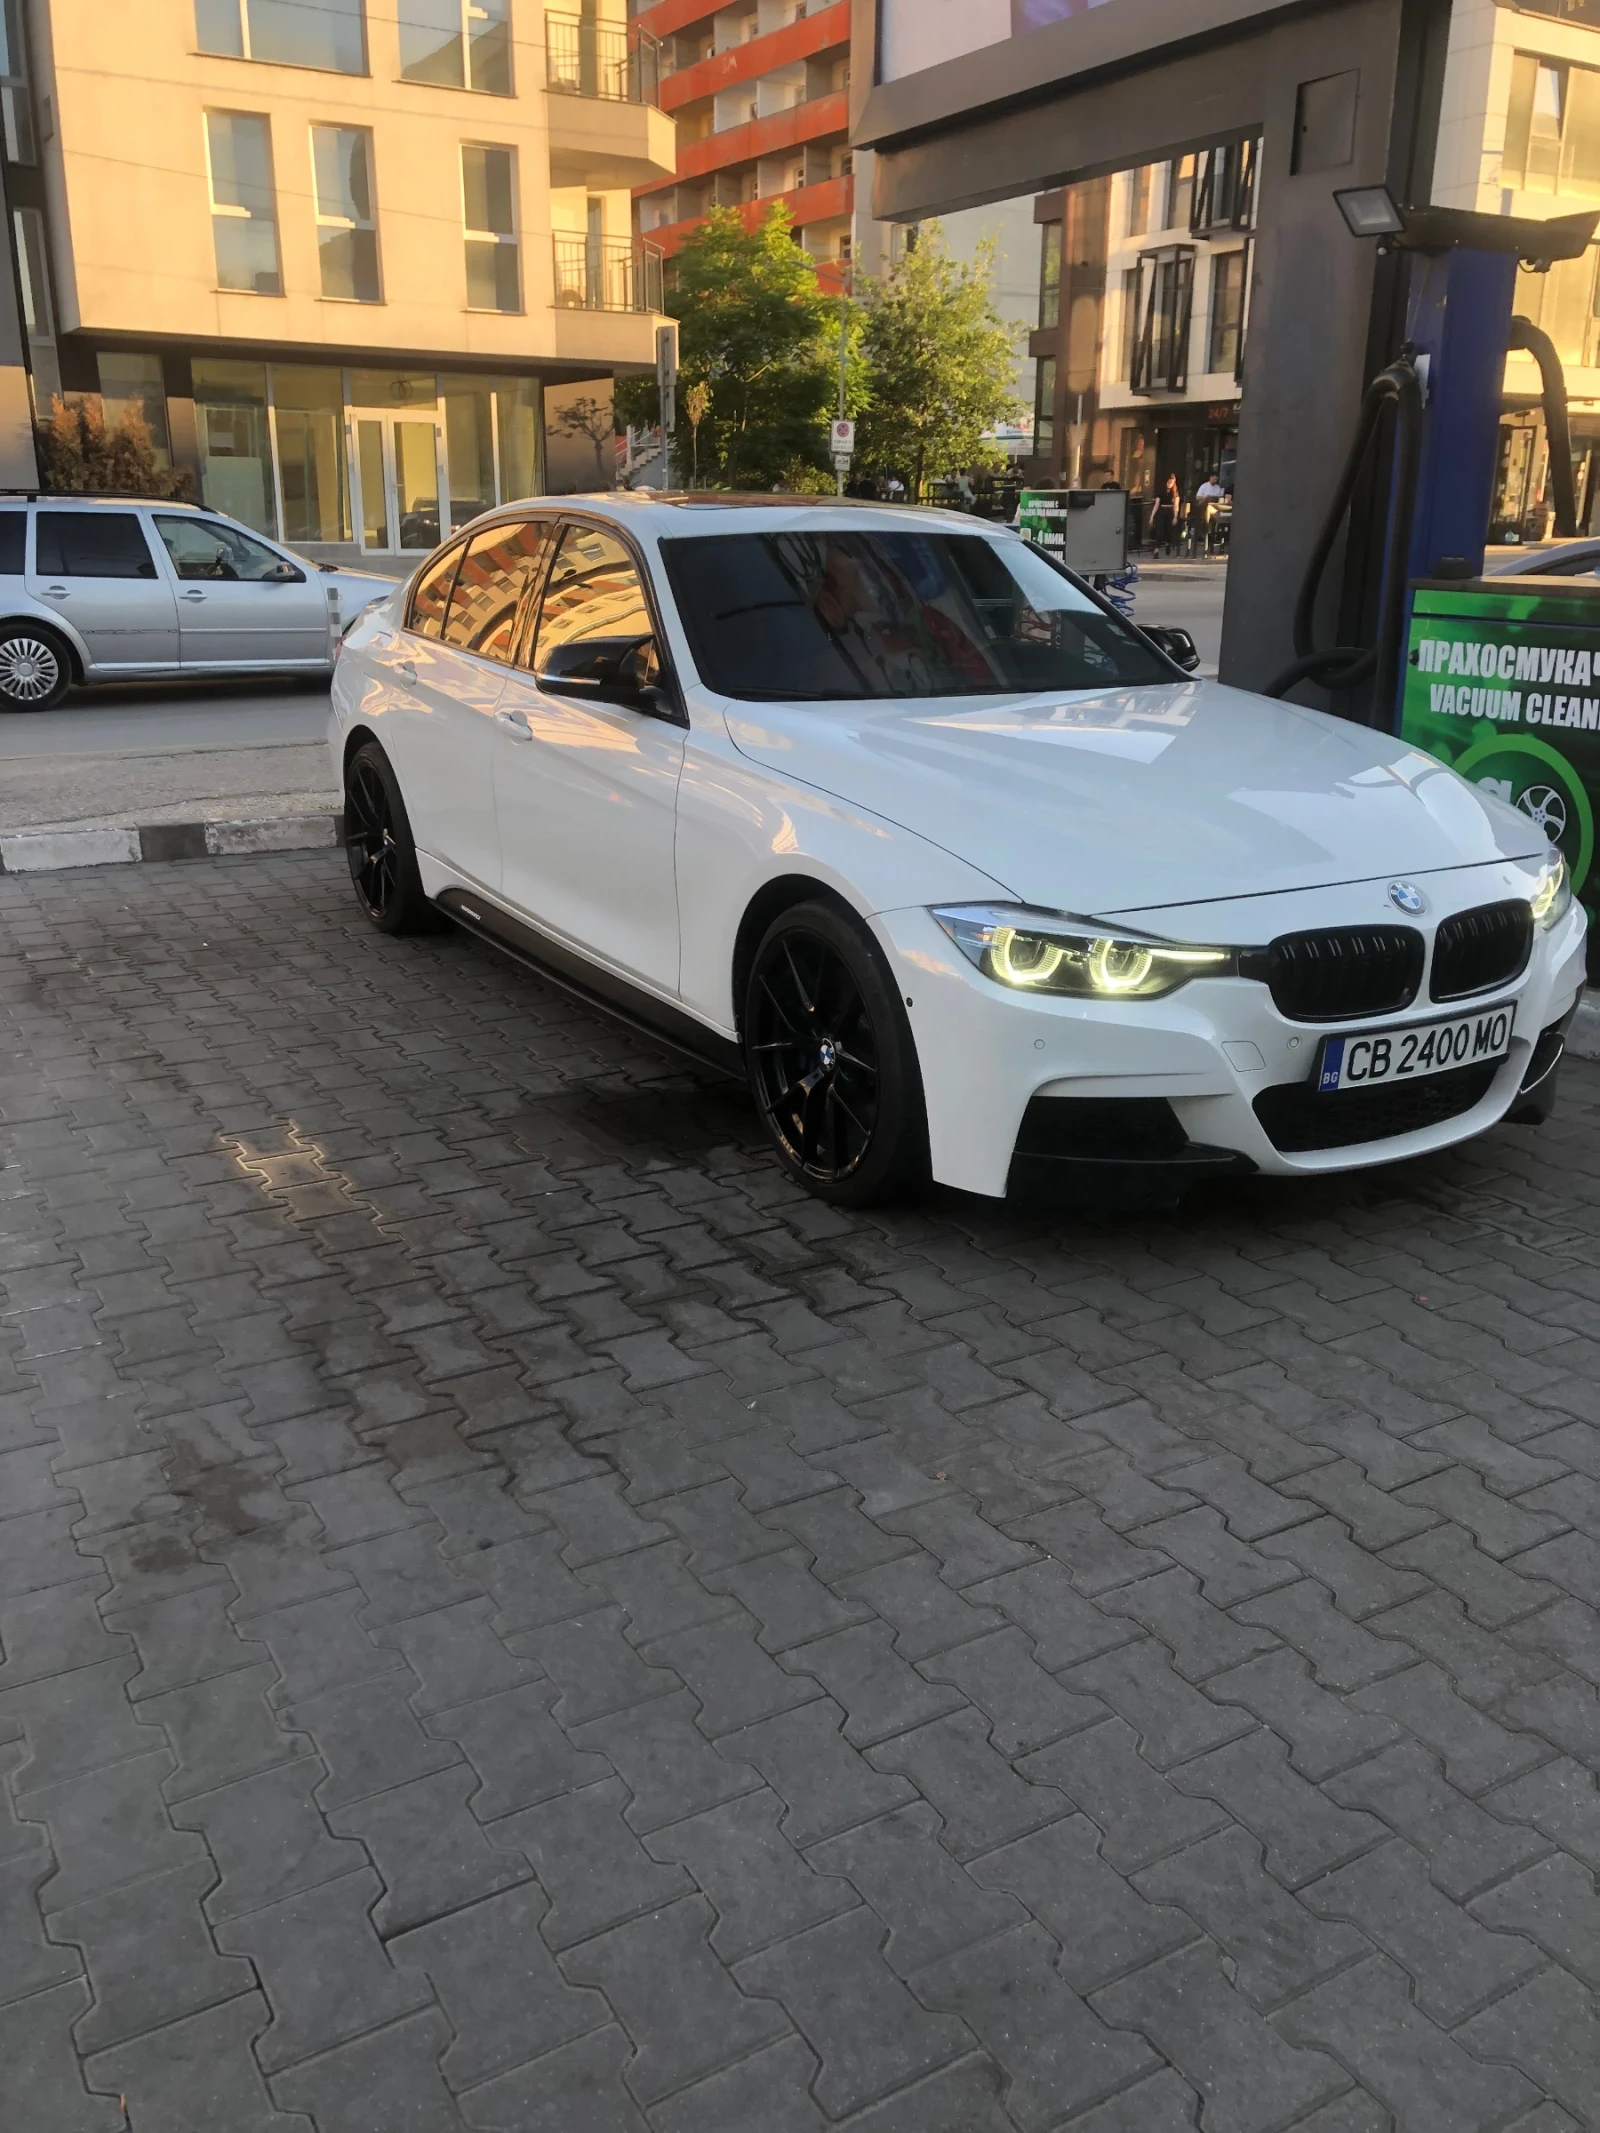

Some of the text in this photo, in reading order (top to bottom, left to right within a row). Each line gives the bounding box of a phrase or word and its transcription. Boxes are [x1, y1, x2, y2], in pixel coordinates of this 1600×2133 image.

[1037, 530, 1043, 544] 4
[1044, 533, 1065, 545] МИН.
[1430, 683, 1600, 731] VACUUM CLEAN
[1347, 1013, 1507, 1081] CB 2400 MO
[1322, 1071, 1338, 1084] BG
